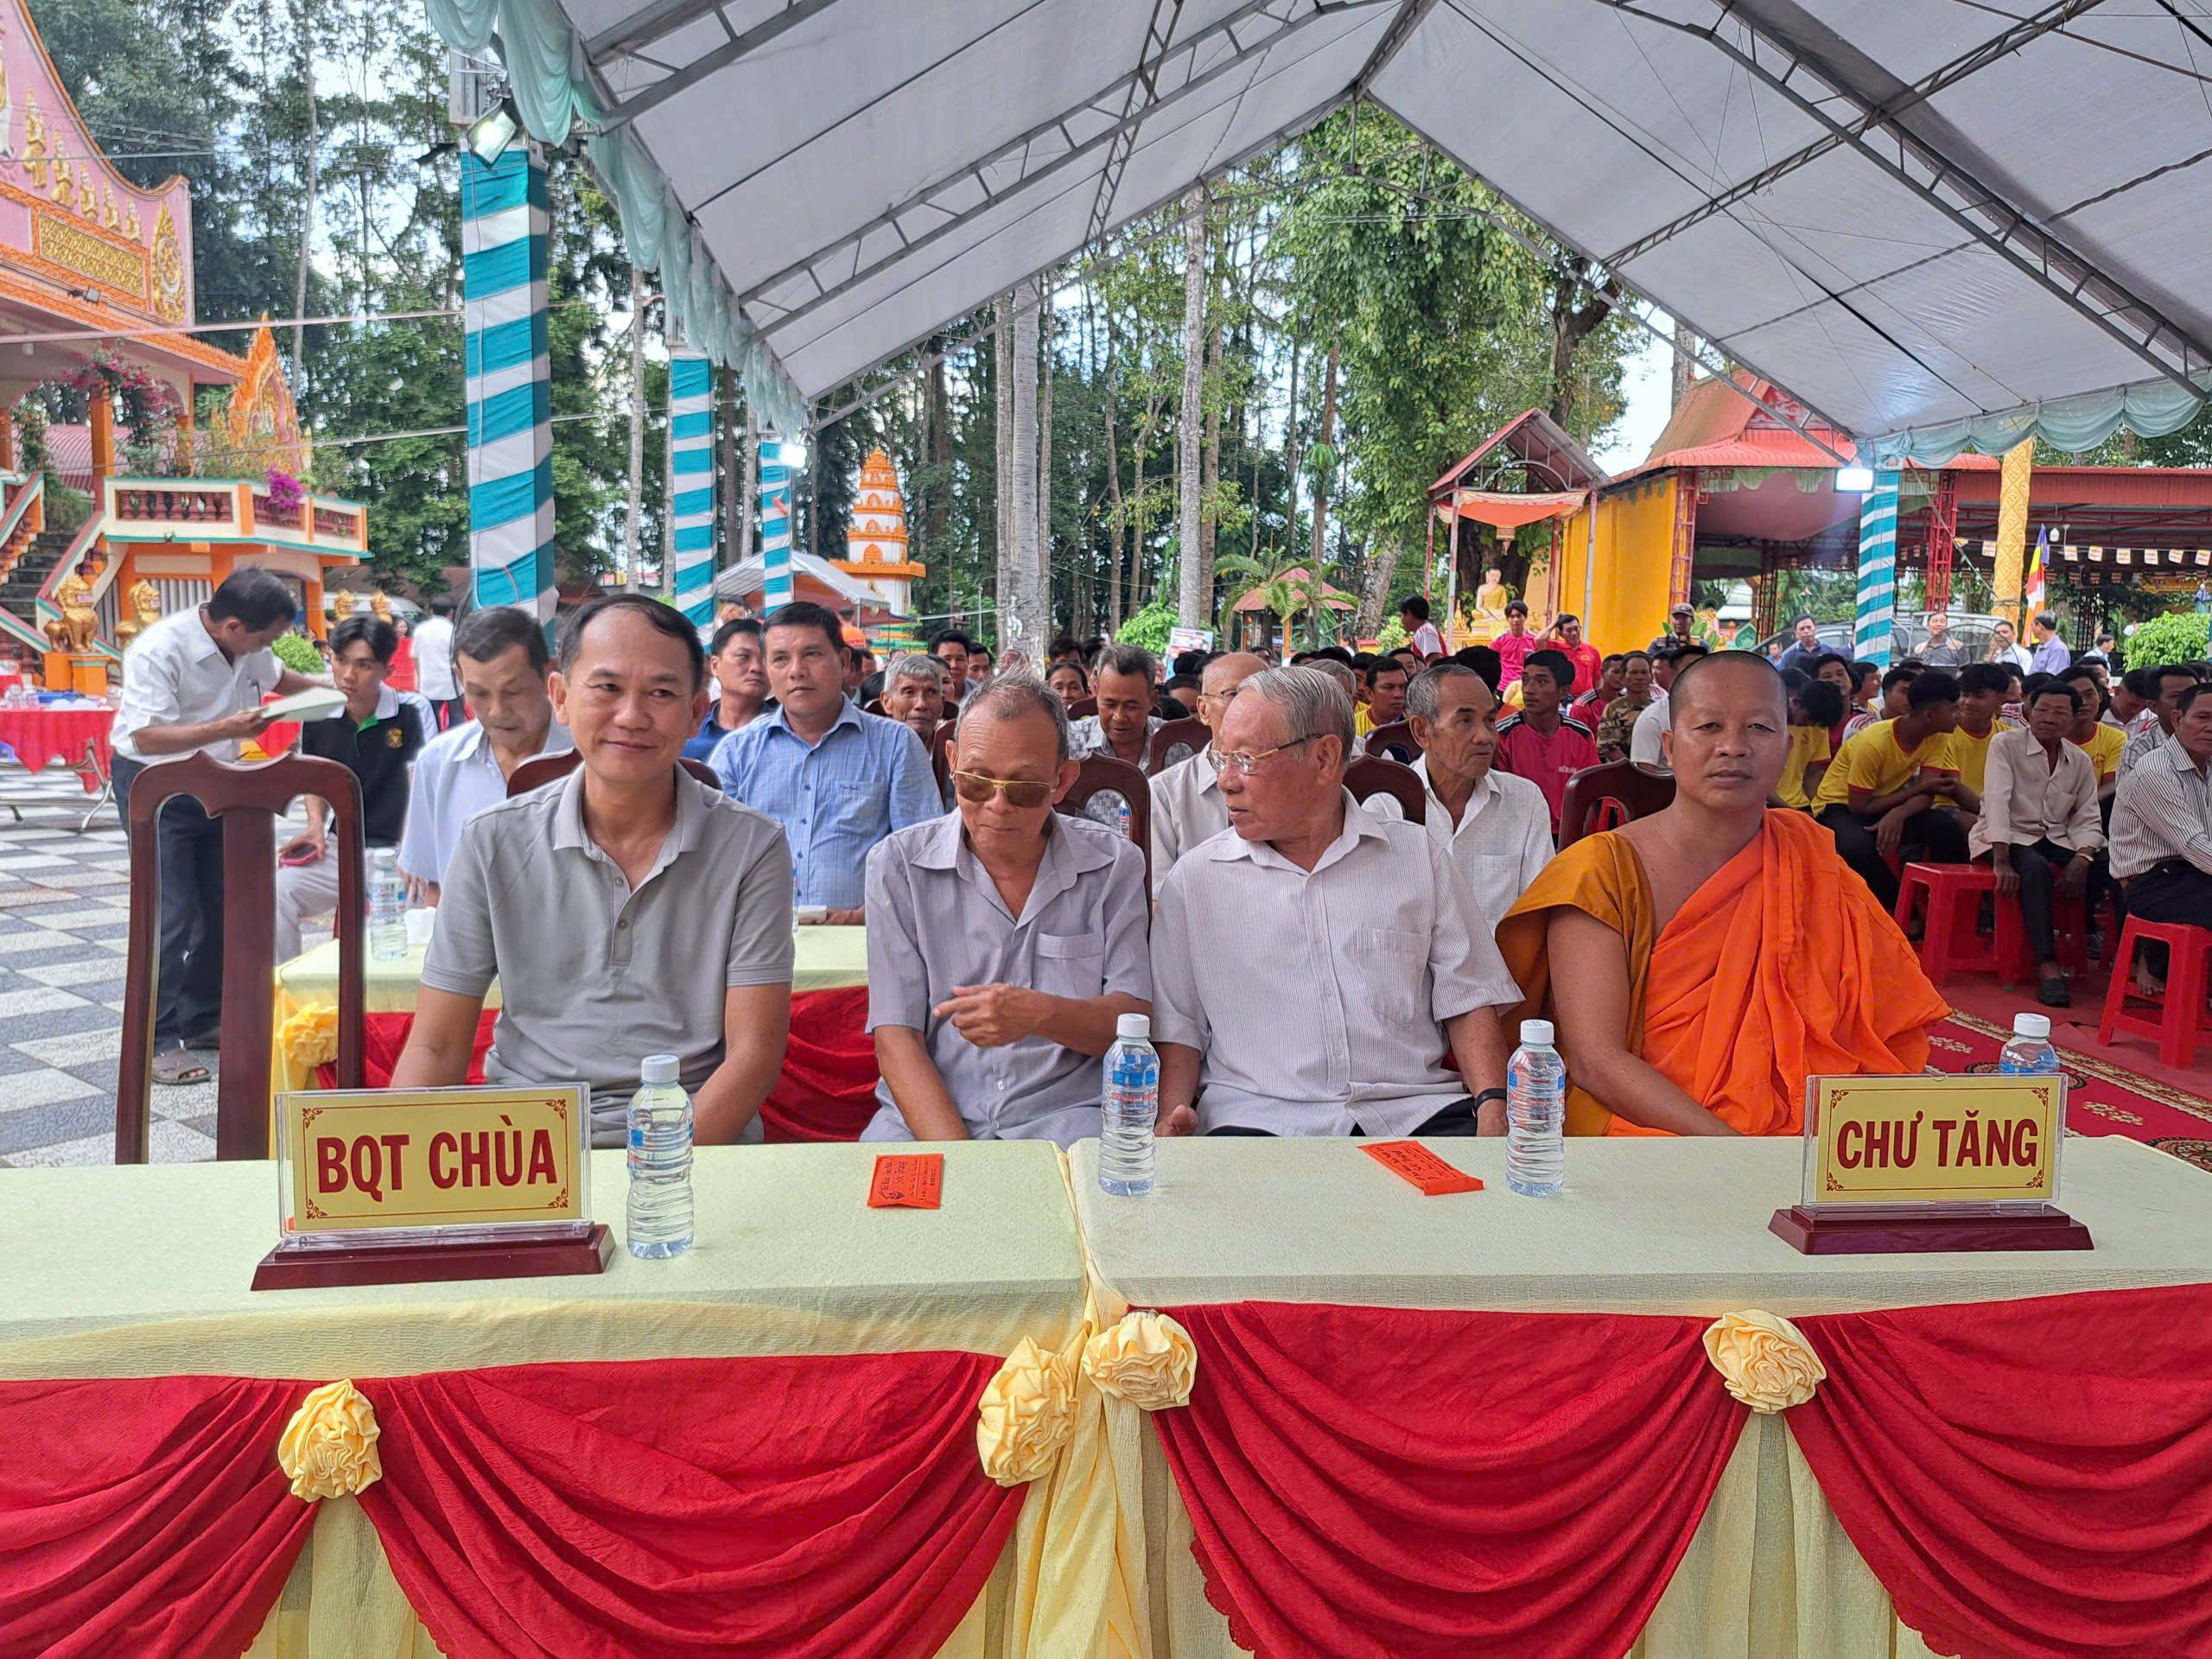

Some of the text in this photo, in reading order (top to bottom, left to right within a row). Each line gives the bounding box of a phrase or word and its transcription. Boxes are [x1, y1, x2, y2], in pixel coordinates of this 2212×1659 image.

[316, 1115, 557, 1203] BQT CHÙA
[1836, 1109, 2038, 1169] CHƯ TĂNG
